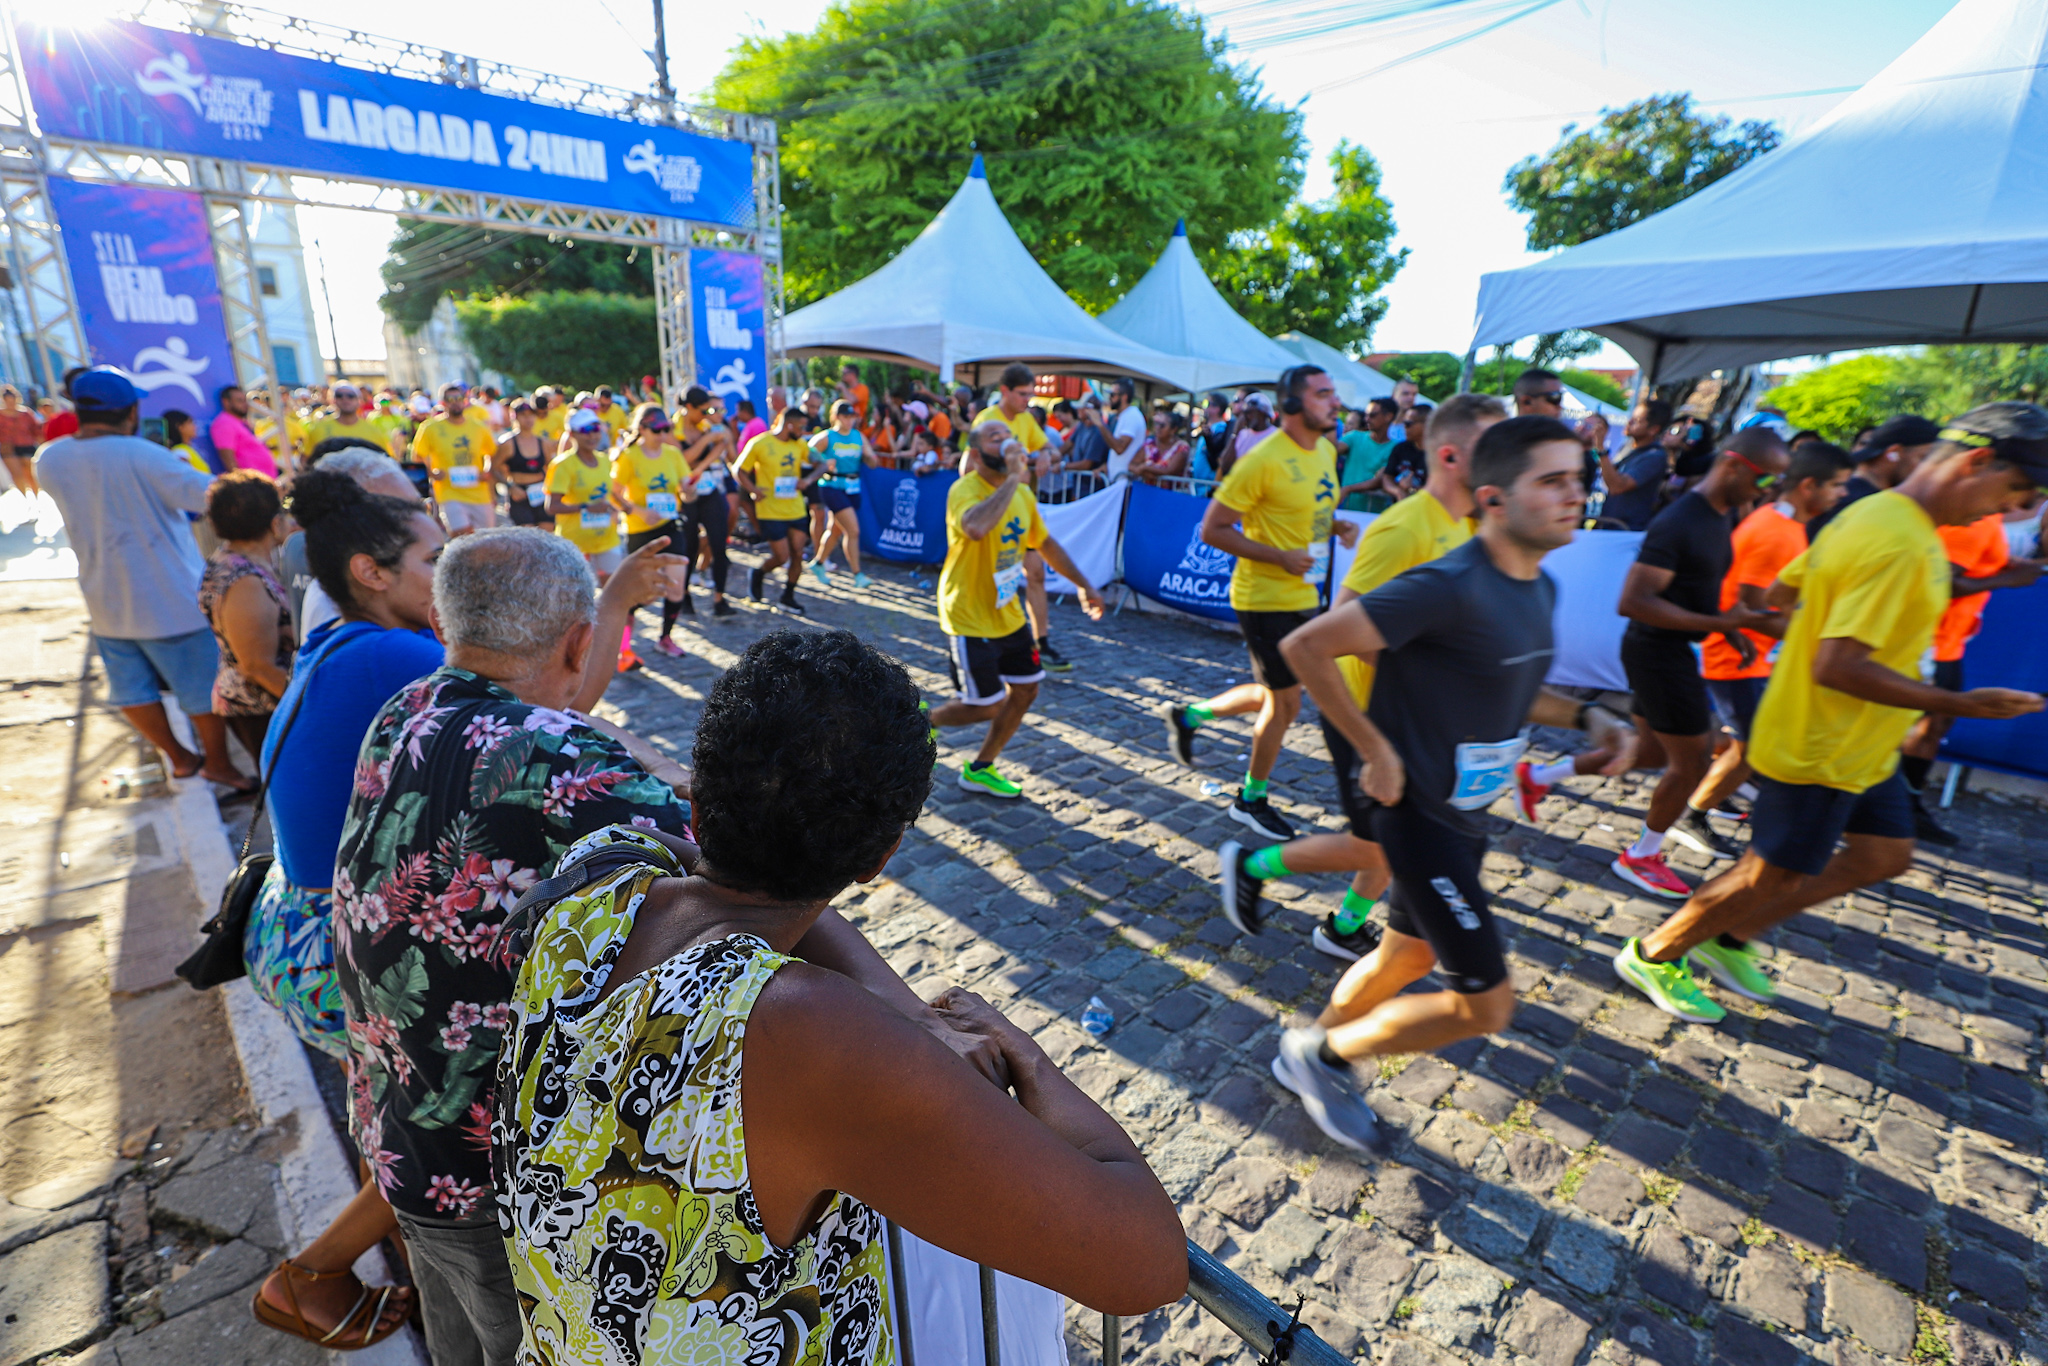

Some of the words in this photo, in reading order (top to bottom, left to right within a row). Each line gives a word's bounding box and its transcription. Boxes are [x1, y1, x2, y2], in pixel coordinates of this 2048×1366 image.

[221, 123, 263, 141] 2024
[298, 88, 501, 167] LARGADA
[504, 125, 609, 183] 24KM
[99, 264, 166, 295] BEM
[879, 528, 925, 547] ARACAJU
[1159, 571, 1231, 598] ARACAJ
